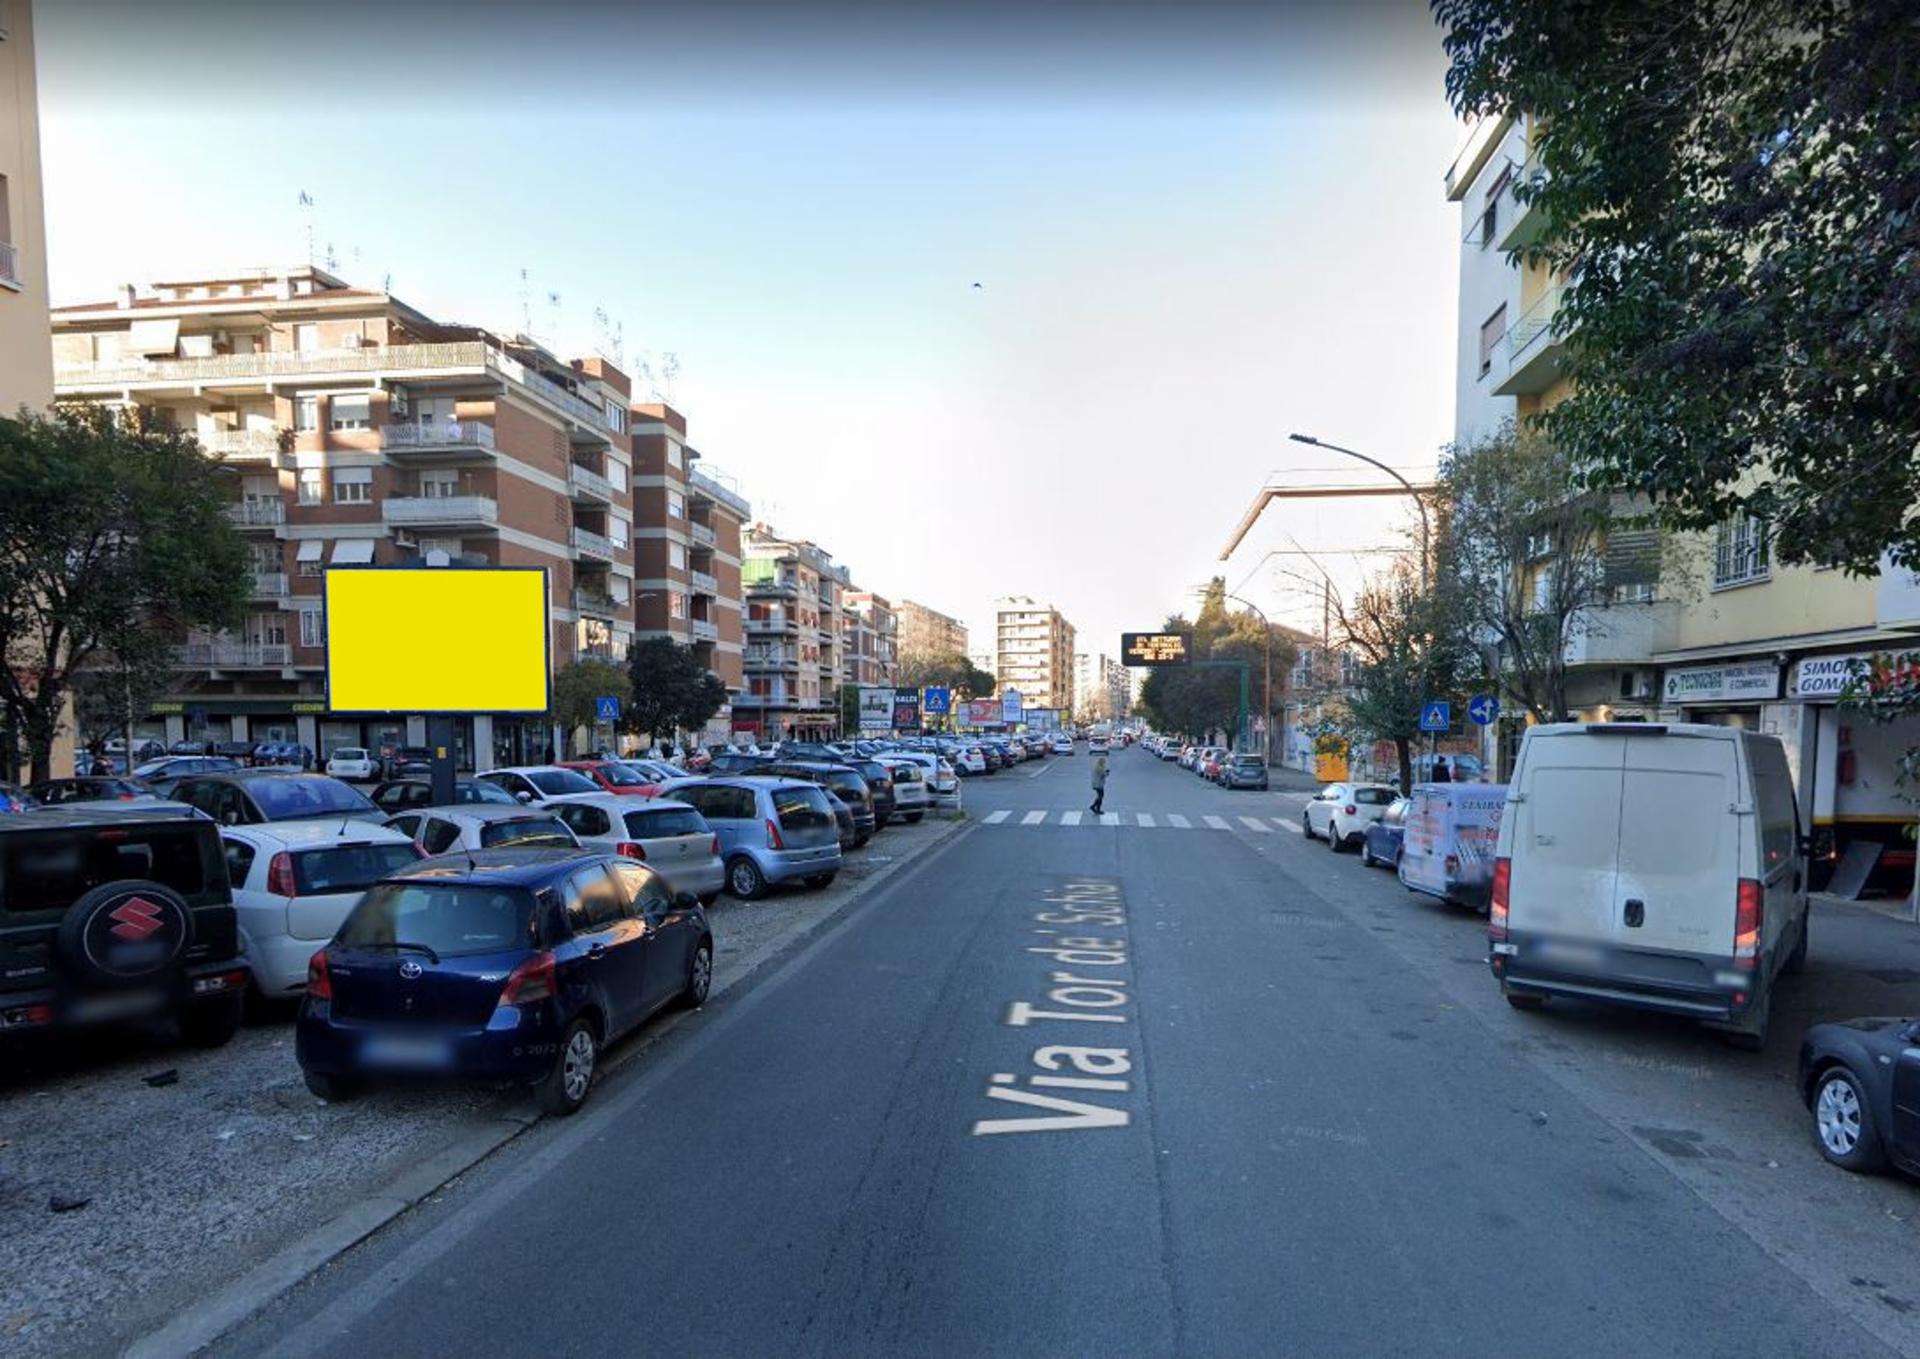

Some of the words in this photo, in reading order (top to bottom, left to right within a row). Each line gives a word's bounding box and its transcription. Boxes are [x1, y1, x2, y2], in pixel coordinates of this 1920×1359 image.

[1801, 674, 1868, 692] GOMM
[1035, 876, 1127, 926] Schia
[1006, 971, 1127, 1024] Tor
[973, 1044, 1132, 1135] Via
